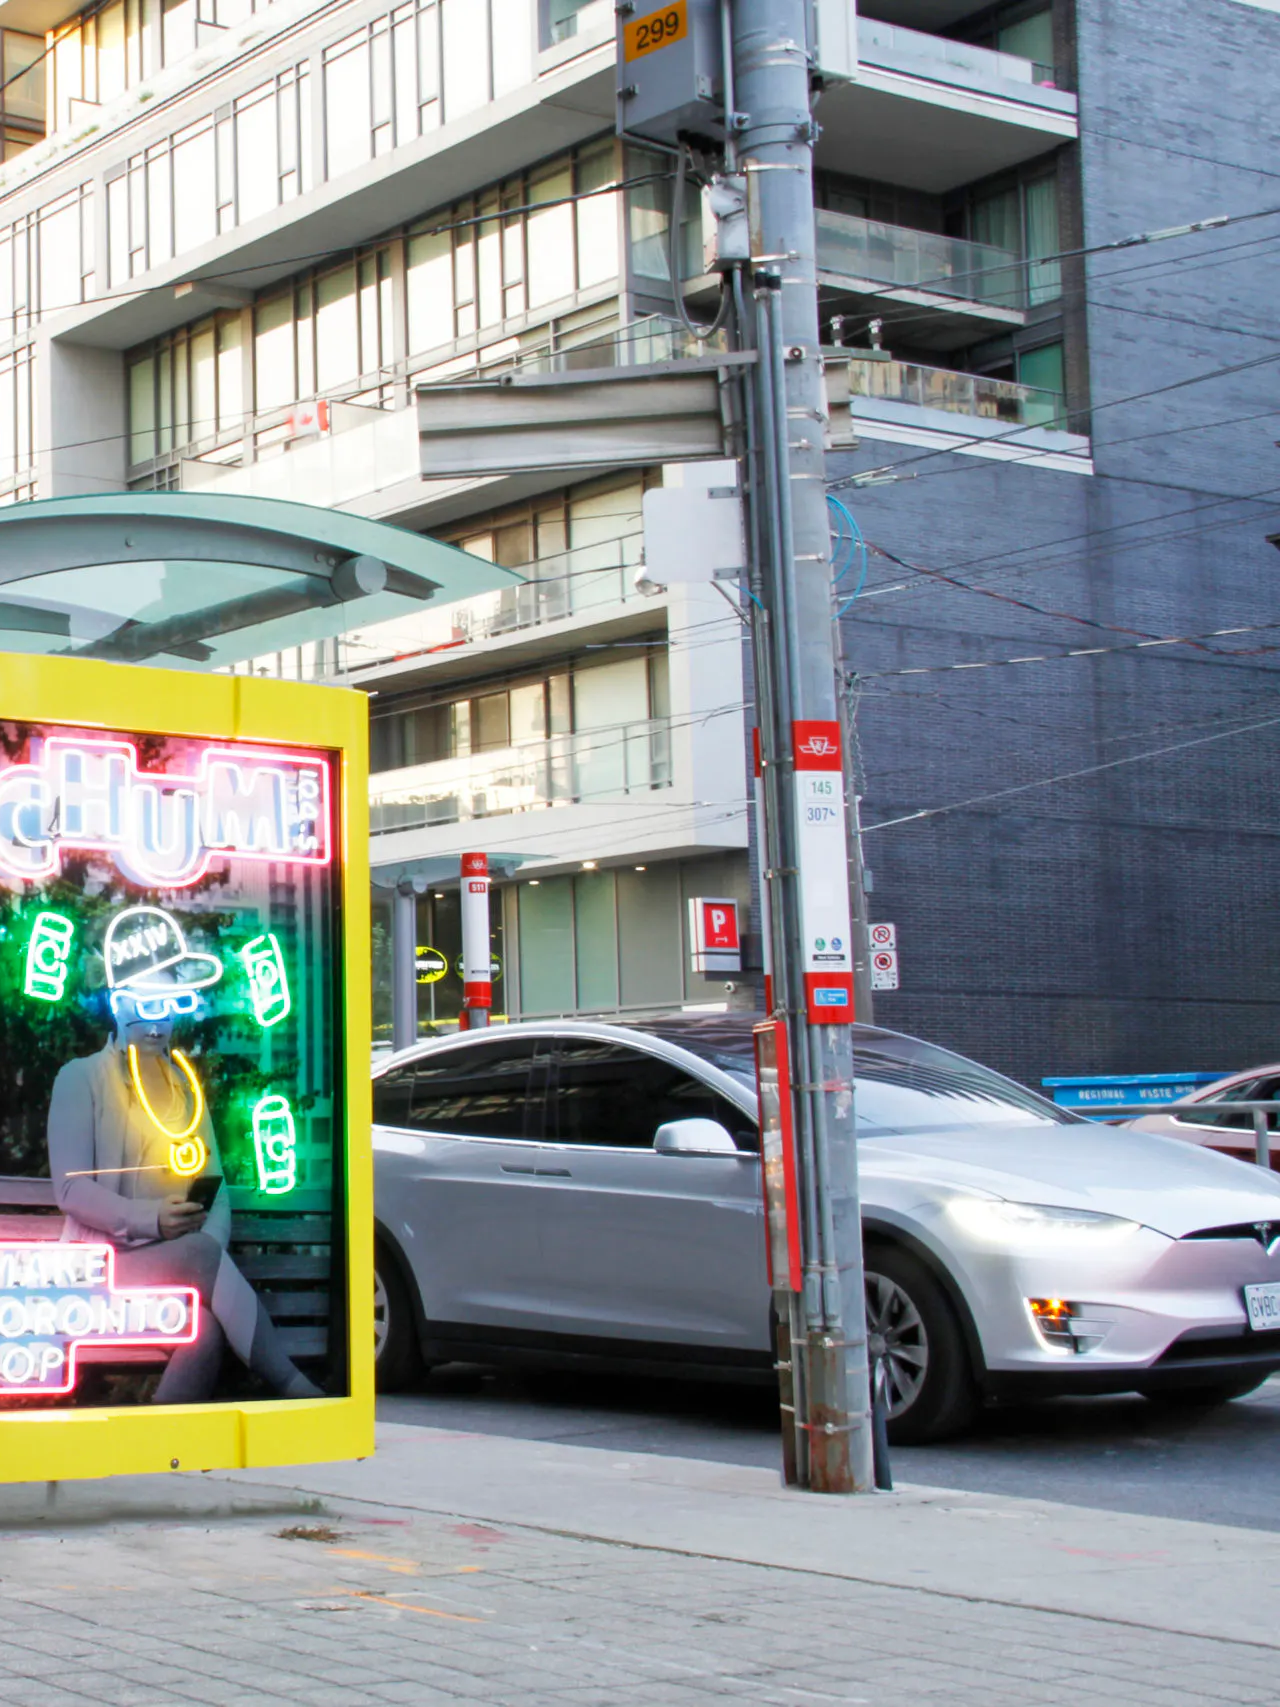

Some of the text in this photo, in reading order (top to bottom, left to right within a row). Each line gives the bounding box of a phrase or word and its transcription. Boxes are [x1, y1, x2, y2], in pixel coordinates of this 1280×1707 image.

[635, 11, 679, 50] 299
[811, 780, 833, 795] 145
[807, 806, 829, 821] 307
[711, 909, 727, 933] P
[110, 921, 168, 966] XXIV
[1139, 1087, 1173, 1099] WASTE
